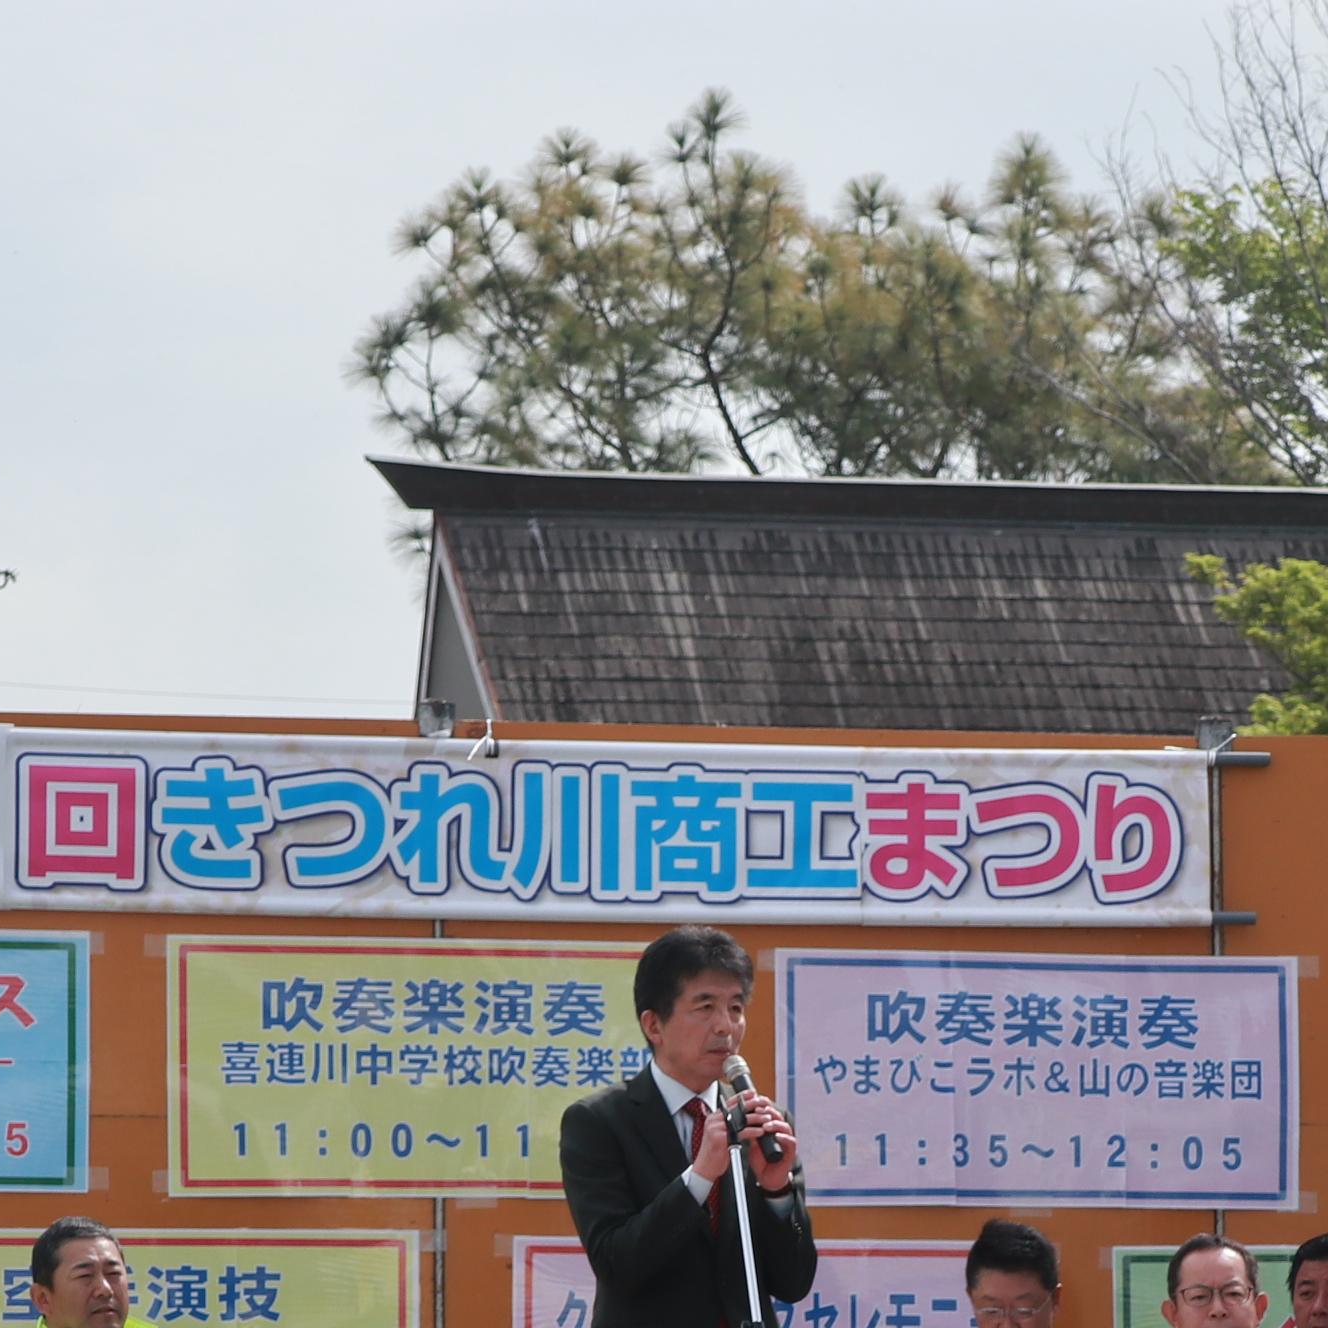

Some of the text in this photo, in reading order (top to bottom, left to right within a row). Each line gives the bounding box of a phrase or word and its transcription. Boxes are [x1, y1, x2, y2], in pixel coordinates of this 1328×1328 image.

[261, 976, 607, 1037] 吹奏楽演奏
[866, 989, 1199, 1051] 吹奏楽演奏
